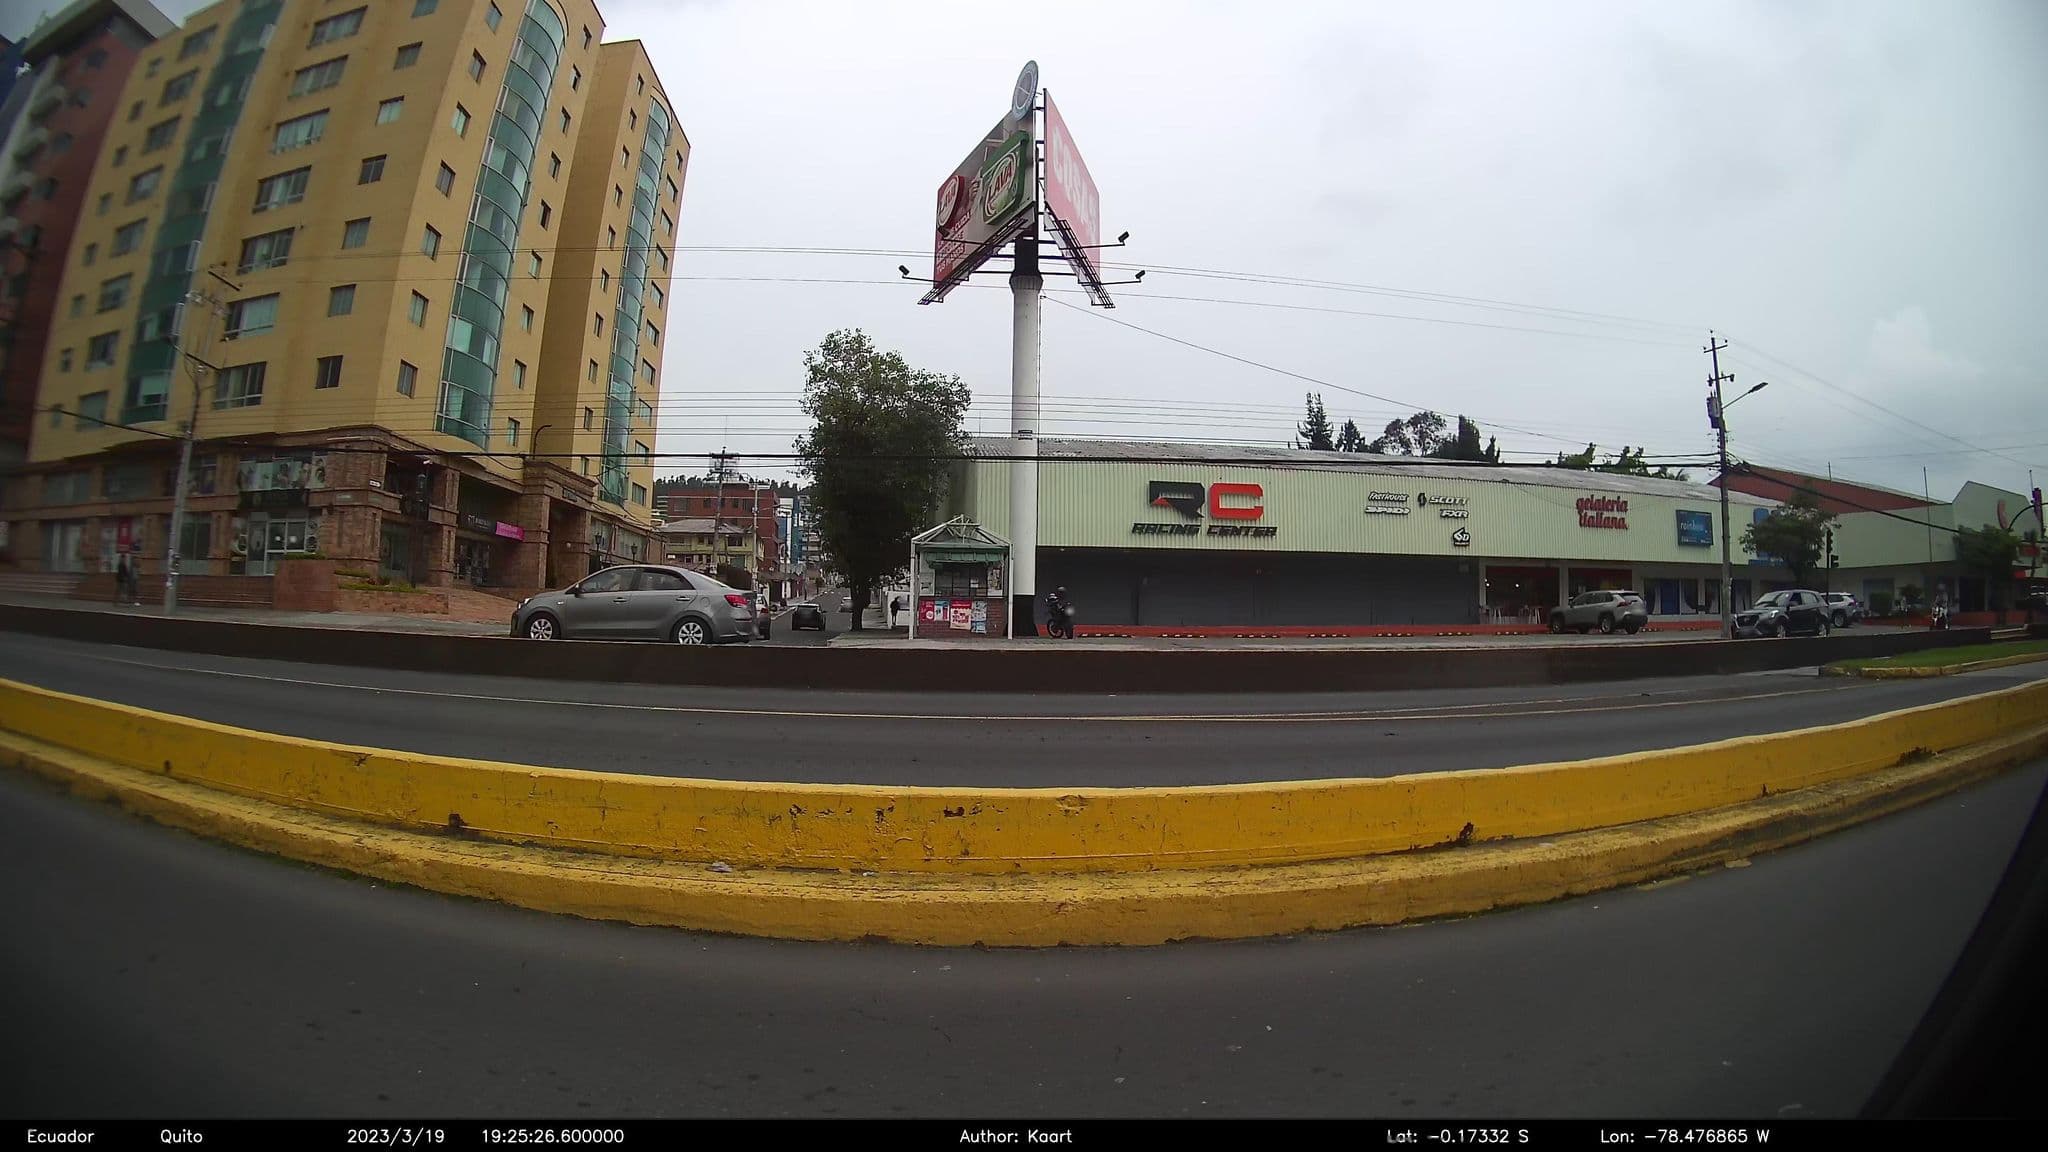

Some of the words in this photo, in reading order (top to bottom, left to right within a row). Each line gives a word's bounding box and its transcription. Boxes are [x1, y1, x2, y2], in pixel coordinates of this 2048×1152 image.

[988, 163, 1013, 204] LAVA
[1149, 480, 1264, 520] RC
[1429, 496, 1468, 505] SCOTT
[1132, 522, 1201, 535] RACING
[1207, 524, 1278, 537] CENTER
